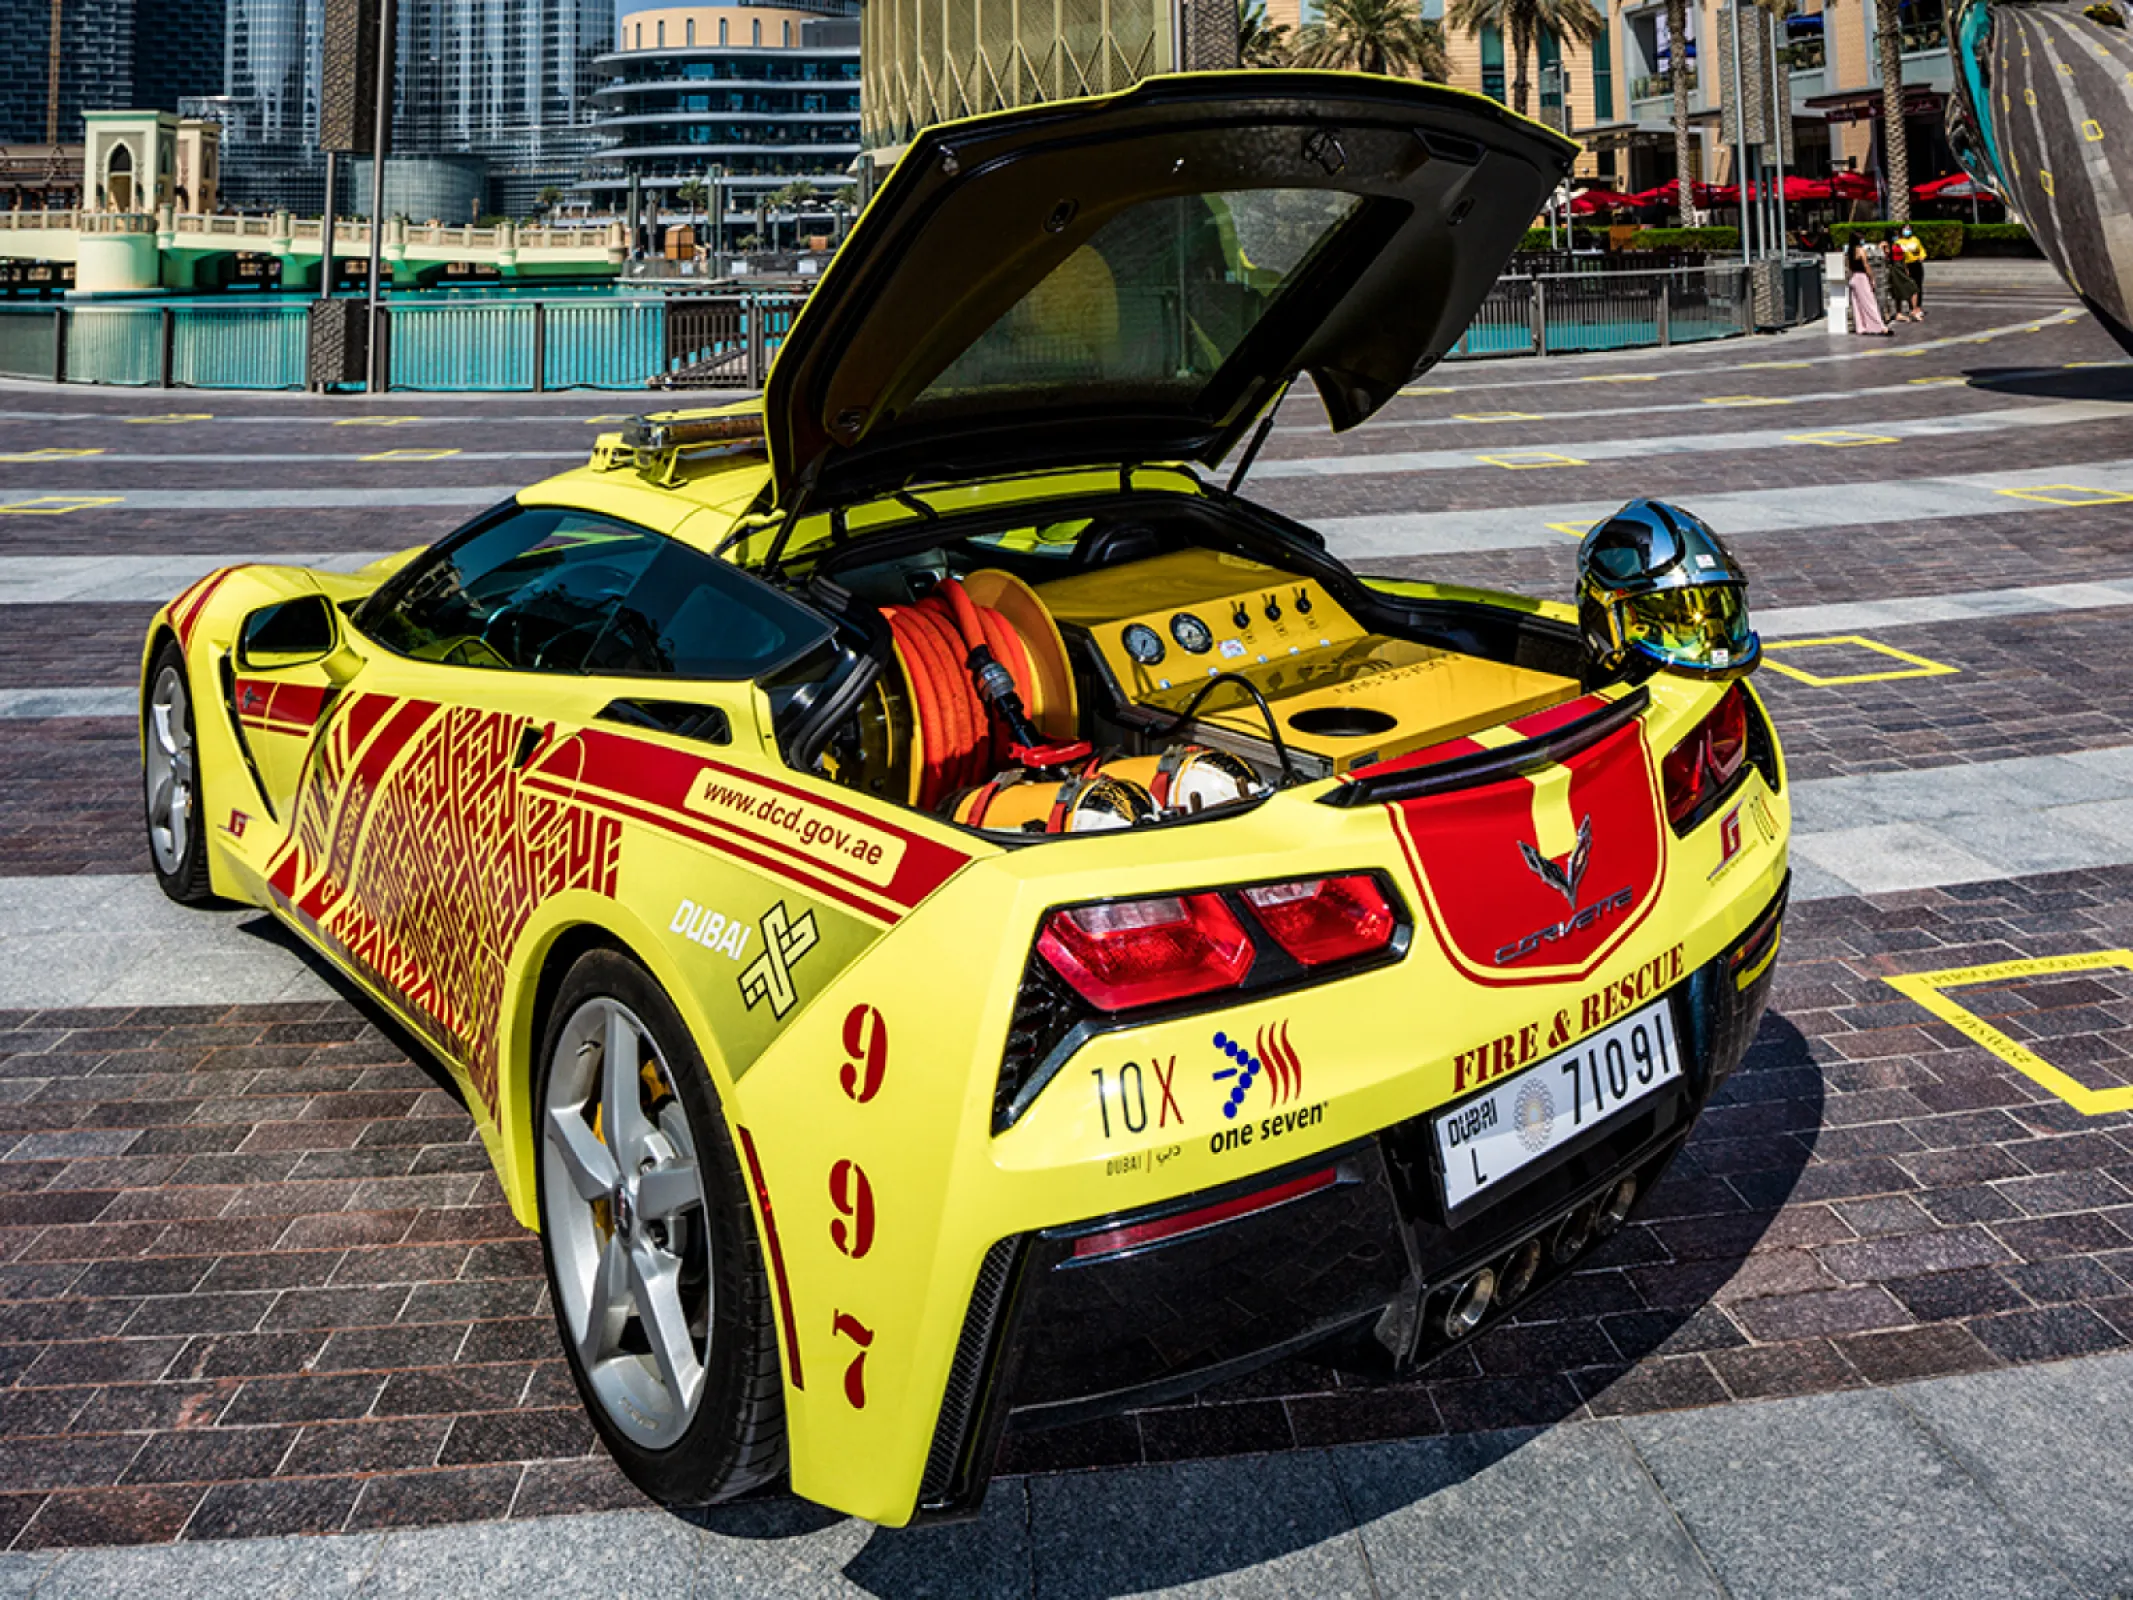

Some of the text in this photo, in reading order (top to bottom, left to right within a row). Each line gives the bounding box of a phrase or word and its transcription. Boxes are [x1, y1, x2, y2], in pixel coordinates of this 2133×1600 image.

[703, 781, 884, 865] www.dcd.gov.ae
[668, 899, 753, 961] DUBAI
[1494, 885, 1634, 965] CORVETTE
[1452, 942, 1685, 1093] FIRE & RESCUE
[1091, 1054, 1184, 1139] 10X
[1561, 1013, 1671, 1125] 71091
[1106, 1155, 1142, 1177] DUBAI
[1209, 1102, 1323, 1154] one seven
[1471, 1147, 1487, 1185] L
